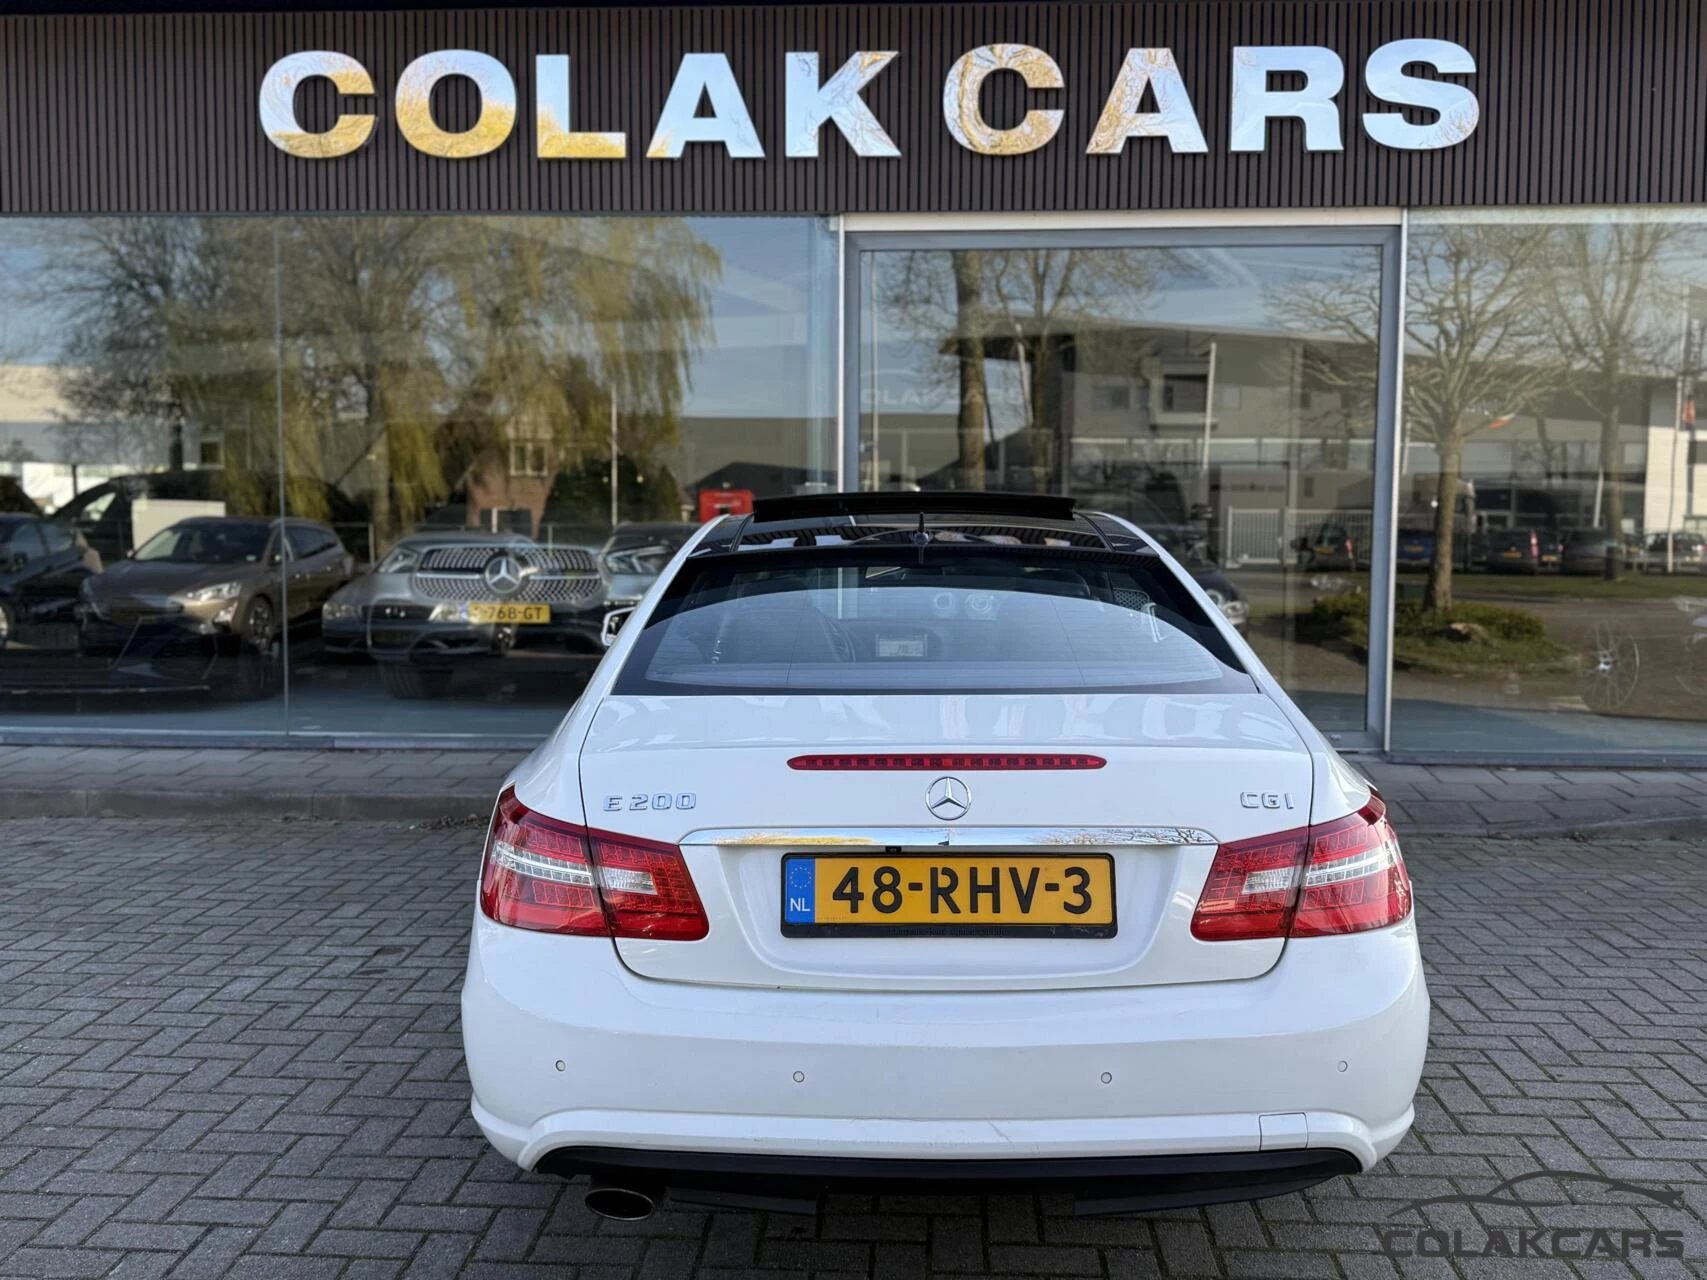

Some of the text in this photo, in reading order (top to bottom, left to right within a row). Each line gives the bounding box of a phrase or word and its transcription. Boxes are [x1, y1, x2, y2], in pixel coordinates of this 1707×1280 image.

[258, 38, 1480, 159] COLAK CARS
[603, 793, 696, 812] E 200
[1240, 792, 1294, 809] CGI
[832, 866, 1092, 915] 48-RHV-3
[790, 897, 811, 912] NL
